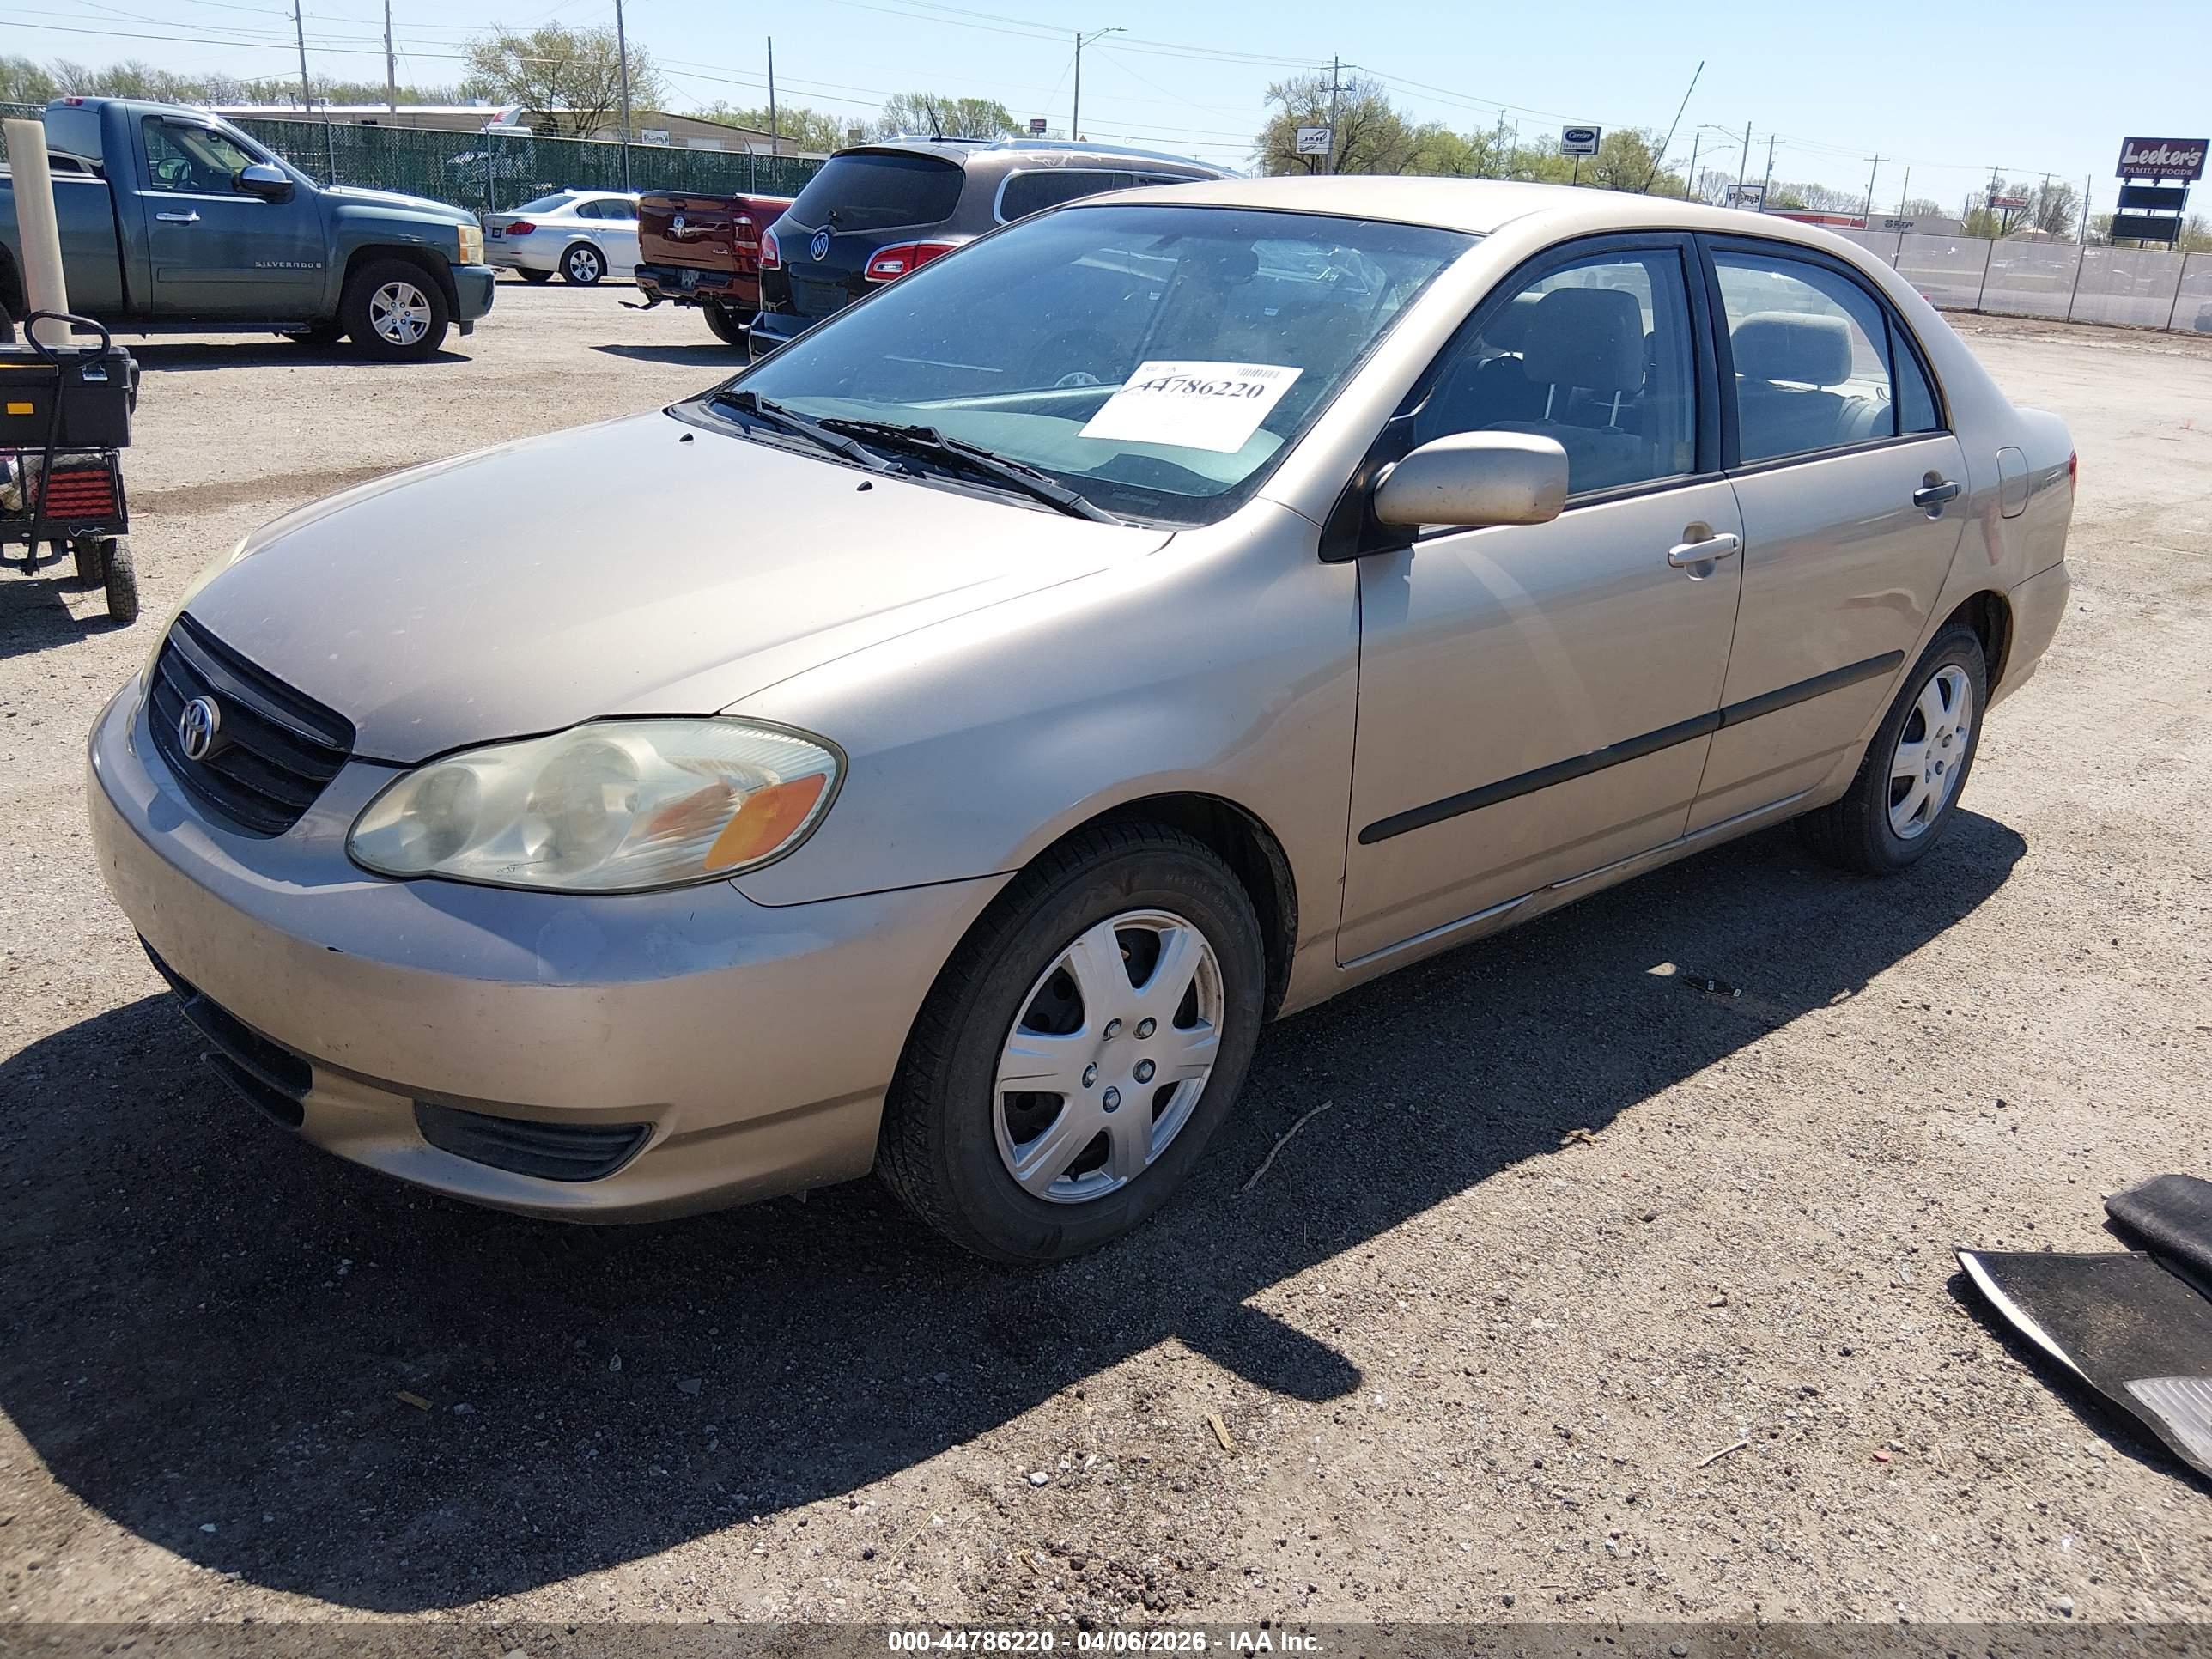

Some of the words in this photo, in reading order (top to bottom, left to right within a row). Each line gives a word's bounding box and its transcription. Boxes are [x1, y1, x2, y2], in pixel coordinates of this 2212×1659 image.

[2122, 143, 2203, 167] Leeker's
[2123, 167, 2159, 175] FAMILY
[2160, 167, 2194, 176] FOODS
[1138, 378, 1266, 399] 44786220
